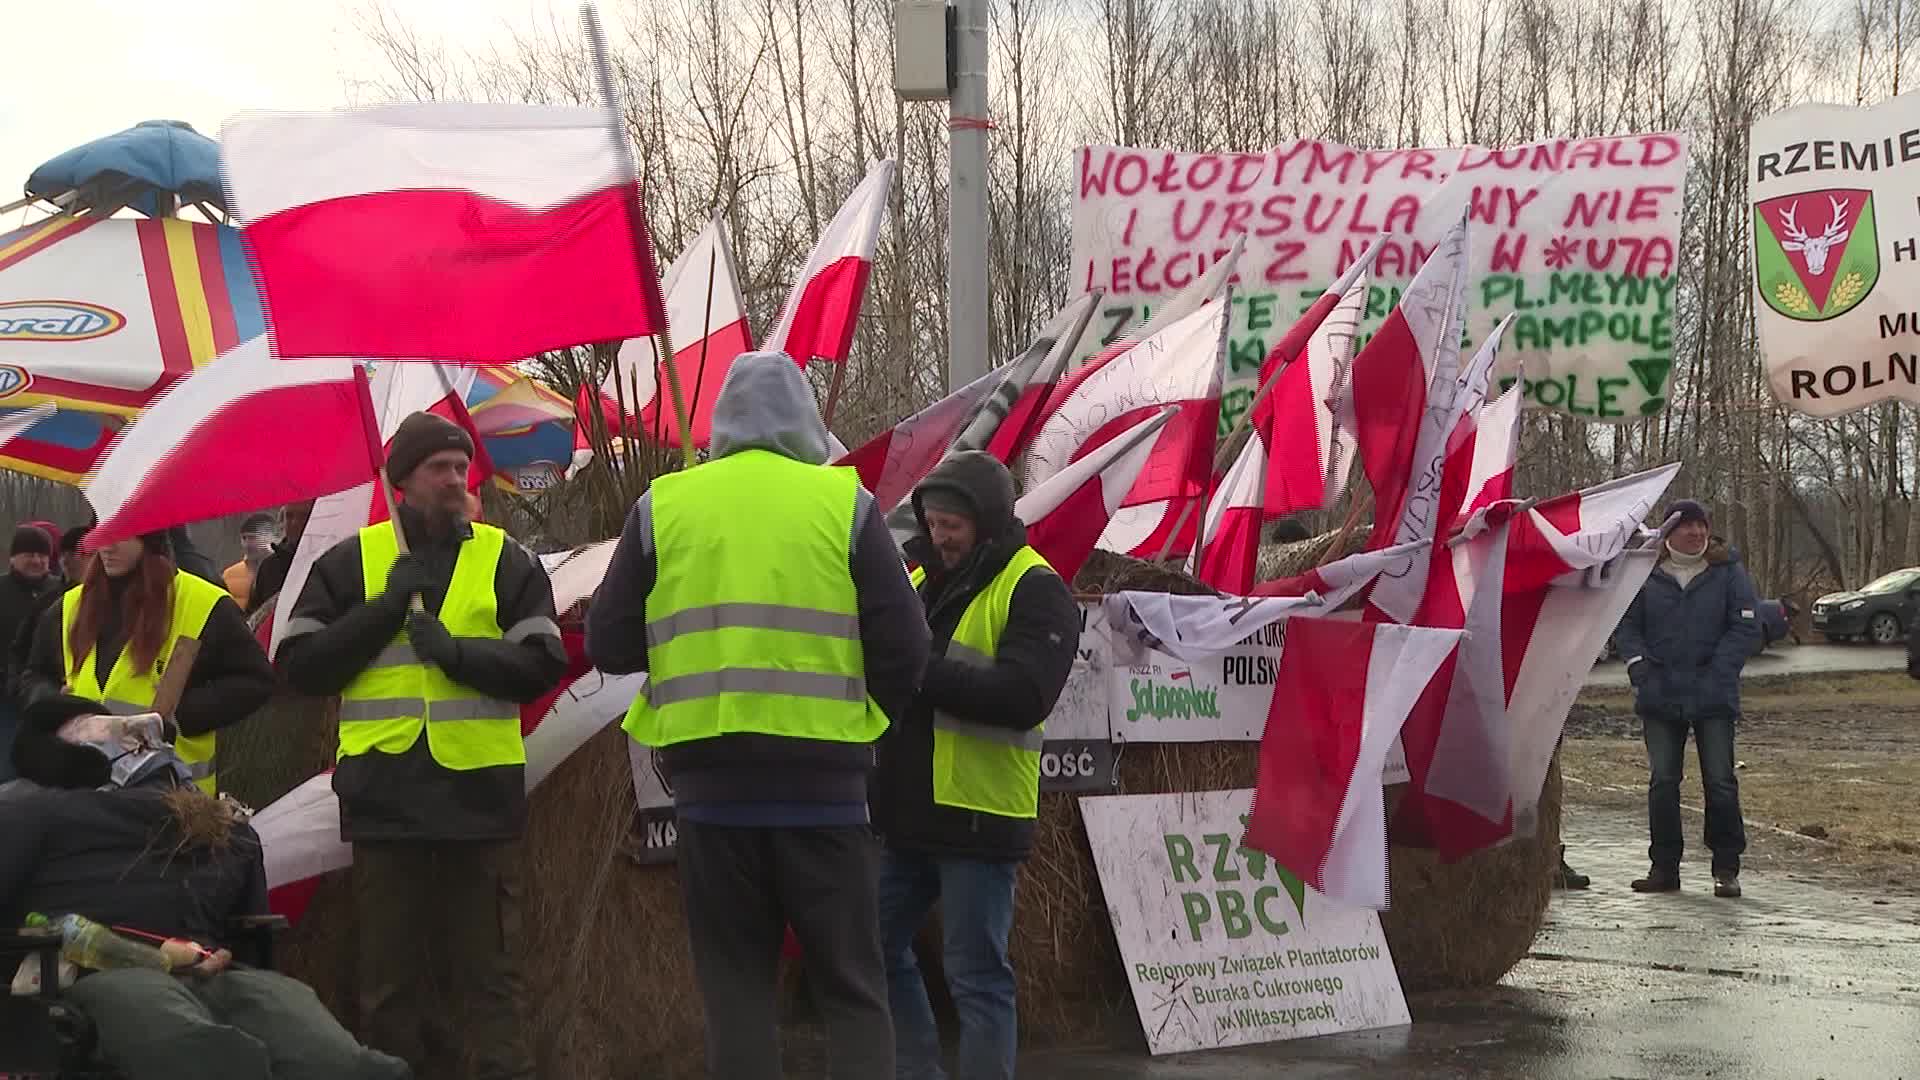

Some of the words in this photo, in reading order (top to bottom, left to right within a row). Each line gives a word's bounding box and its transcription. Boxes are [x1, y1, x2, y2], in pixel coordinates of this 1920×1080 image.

[1122, 207, 1138, 246] I
[1172, 191, 1421, 242] URSULA
[1468, 185, 1539, 228] WY
[1563, 185, 1675, 228] NIE
[1264, 242, 1309, 282] Z
[1489, 232, 1528, 273] W
[1180, 885, 1290, 942] PBC
[1135, 961, 1216, 985] Rejonowy
[1218, 955, 1285, 977] Związek
[1287, 942, 1380, 969] Plantatorów
[1191, 984, 1250, 1005] Buraka
[1252, 975, 1344, 999] Cukrowego
[1234, 1000, 1336, 1029] Witaszycach
